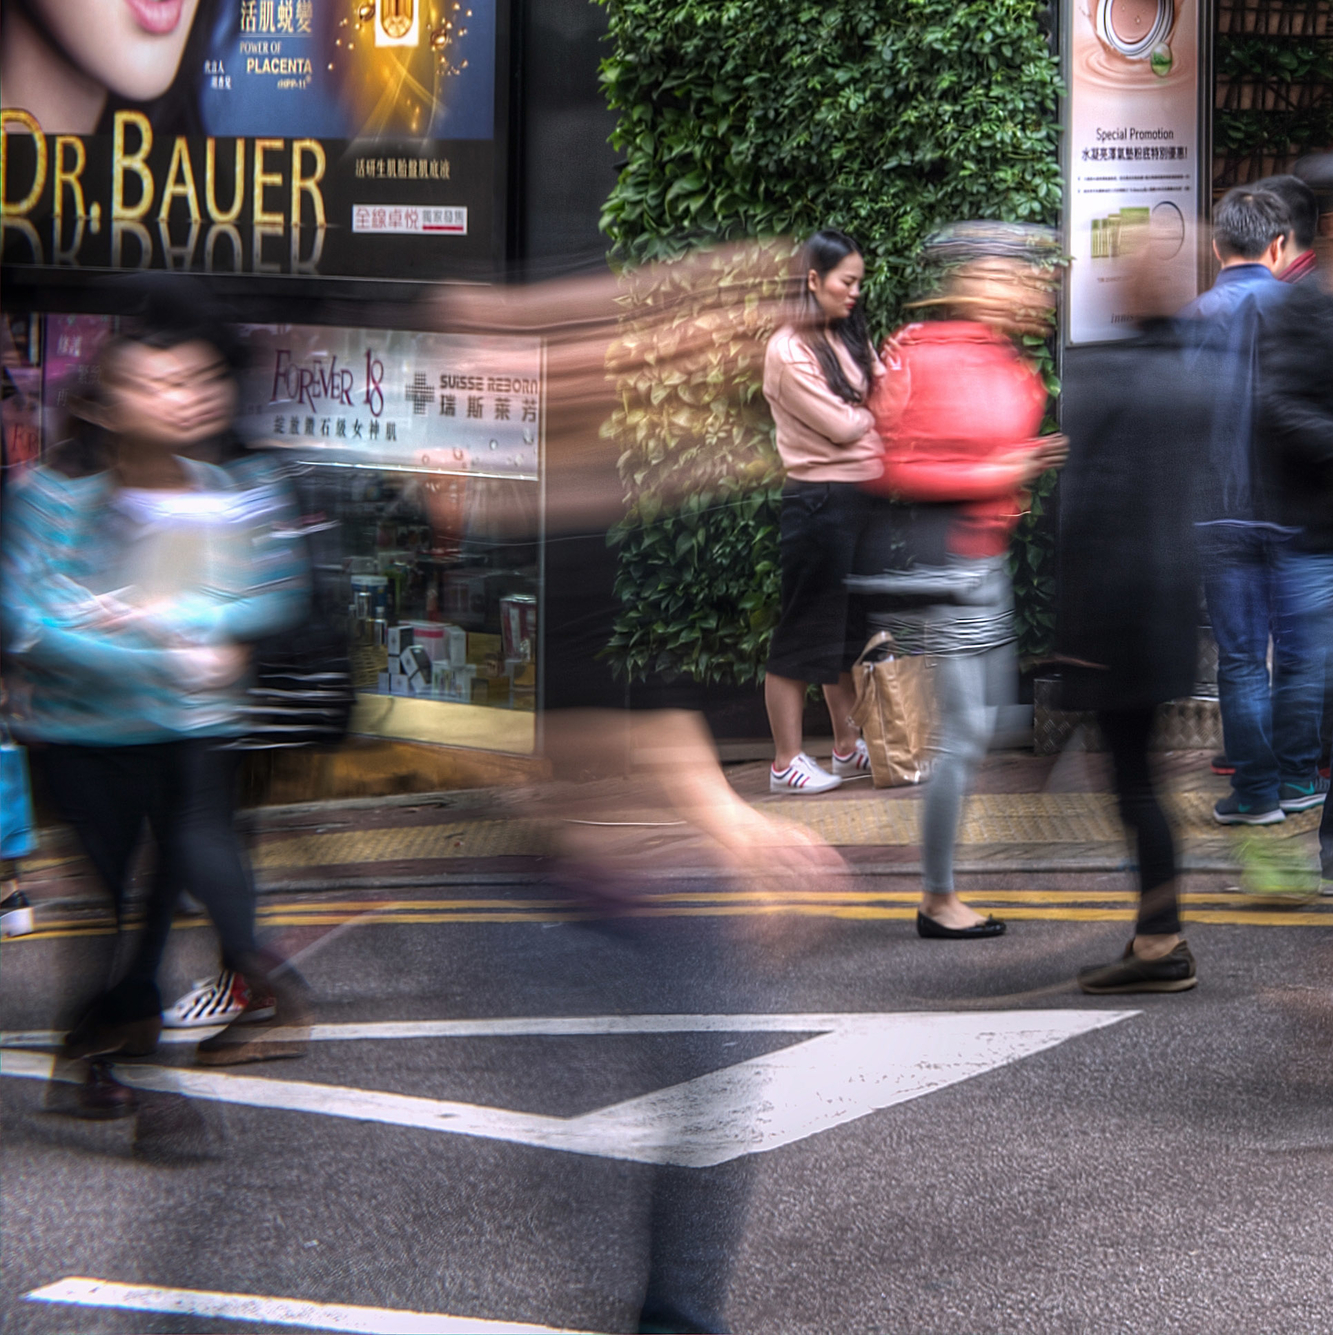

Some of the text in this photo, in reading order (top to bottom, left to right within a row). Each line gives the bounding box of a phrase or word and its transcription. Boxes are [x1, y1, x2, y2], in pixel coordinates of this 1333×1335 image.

[240, 41, 281, 54] POWER OF
[247, 58, 313, 75] PLACENTA
[1096, 127, 1174, 142] Special Promotion
[0, 108, 326, 228] DR. BAUER
[270, 347, 384, 417] FOREVER 18
[440, 393, 538, 422] 瑞斯萊芳
